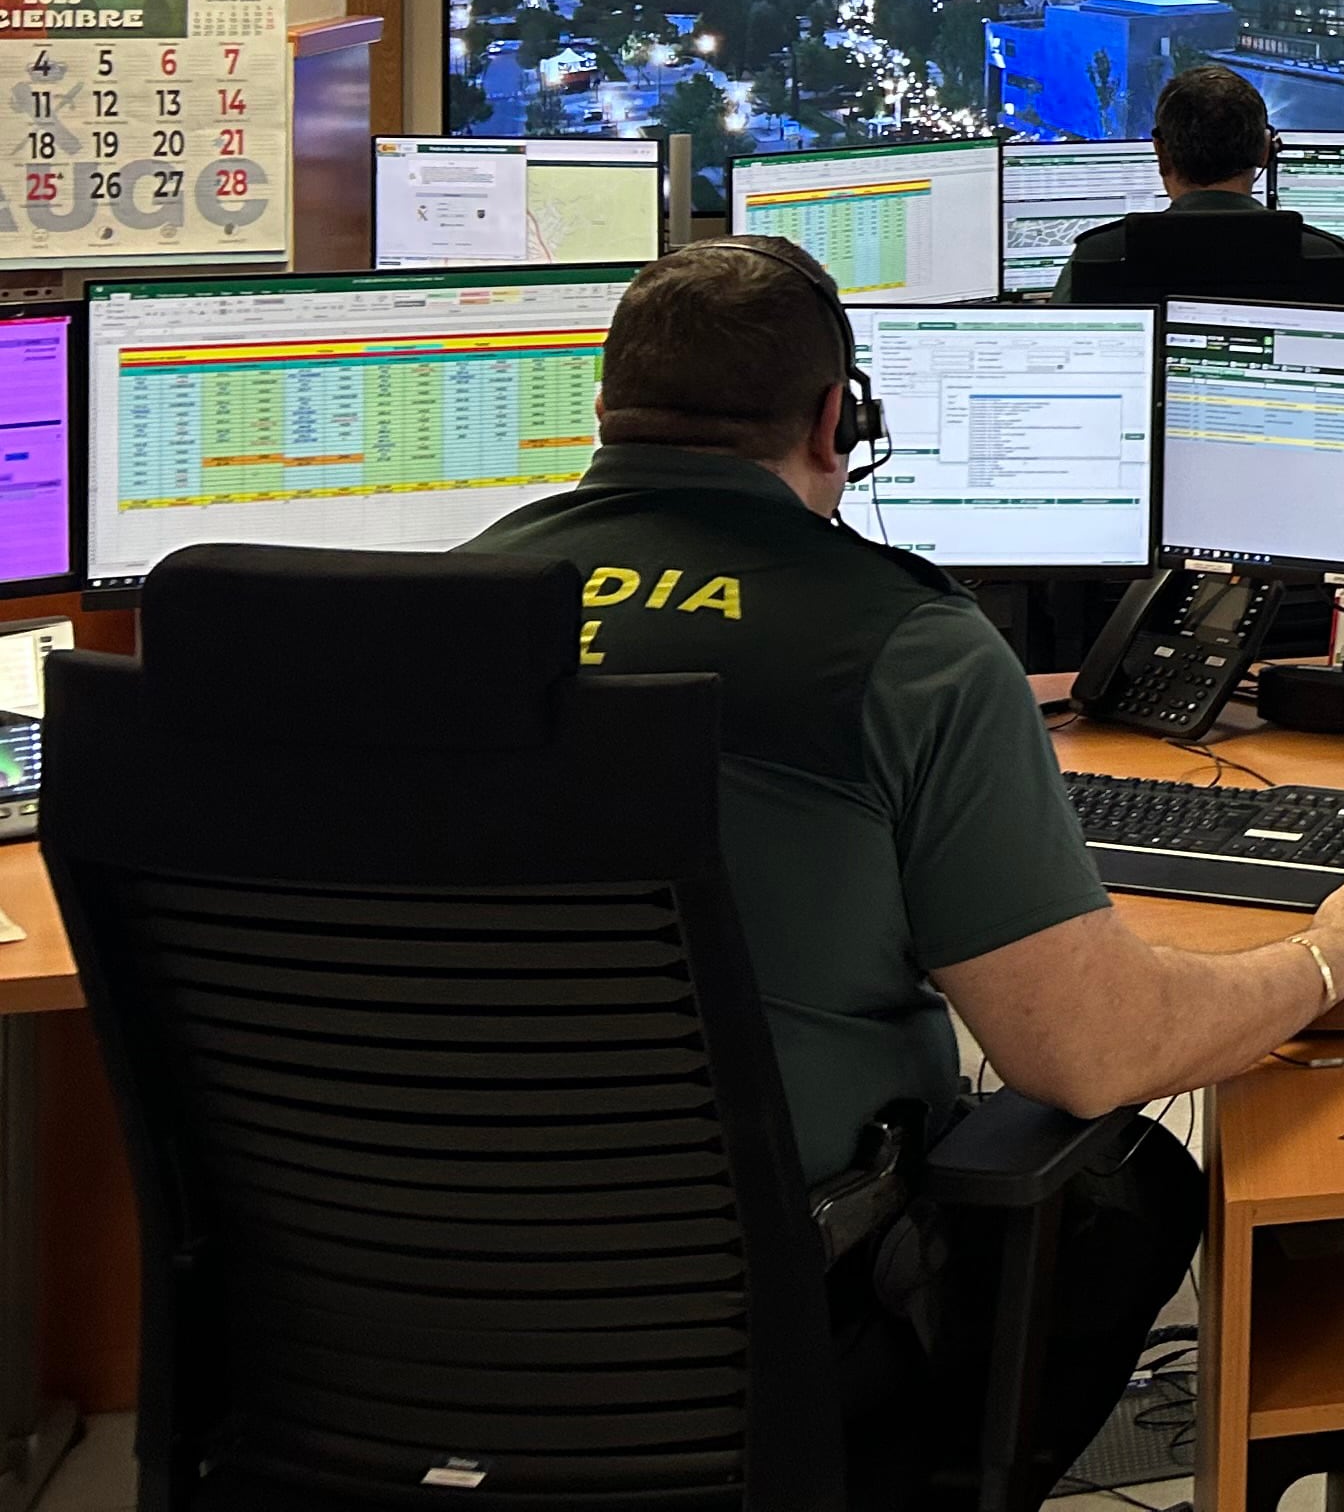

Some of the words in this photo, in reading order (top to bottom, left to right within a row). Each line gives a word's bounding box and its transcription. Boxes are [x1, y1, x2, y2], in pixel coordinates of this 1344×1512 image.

[31, 49, 52, 77] 4
[97, 49, 114, 76] 5
[160, 48, 178, 76] 6
[223, 48, 241, 76] 7
[31, 90, 52, 119] 11
[92, 90, 119, 118] 12
[155, 89, 182, 117] 13
[217, 88, 247, 116] 14
[27, 132, 56, 160] 18
[92, 131, 119, 158] 19
[153, 130, 185, 157] 20
[219, 129, 244, 156] 21
[26, 173, 58, 201] 25
[89, 172, 122, 199] 26
[153, 170, 185, 198] 27
[215, 169, 249, 197] 28
